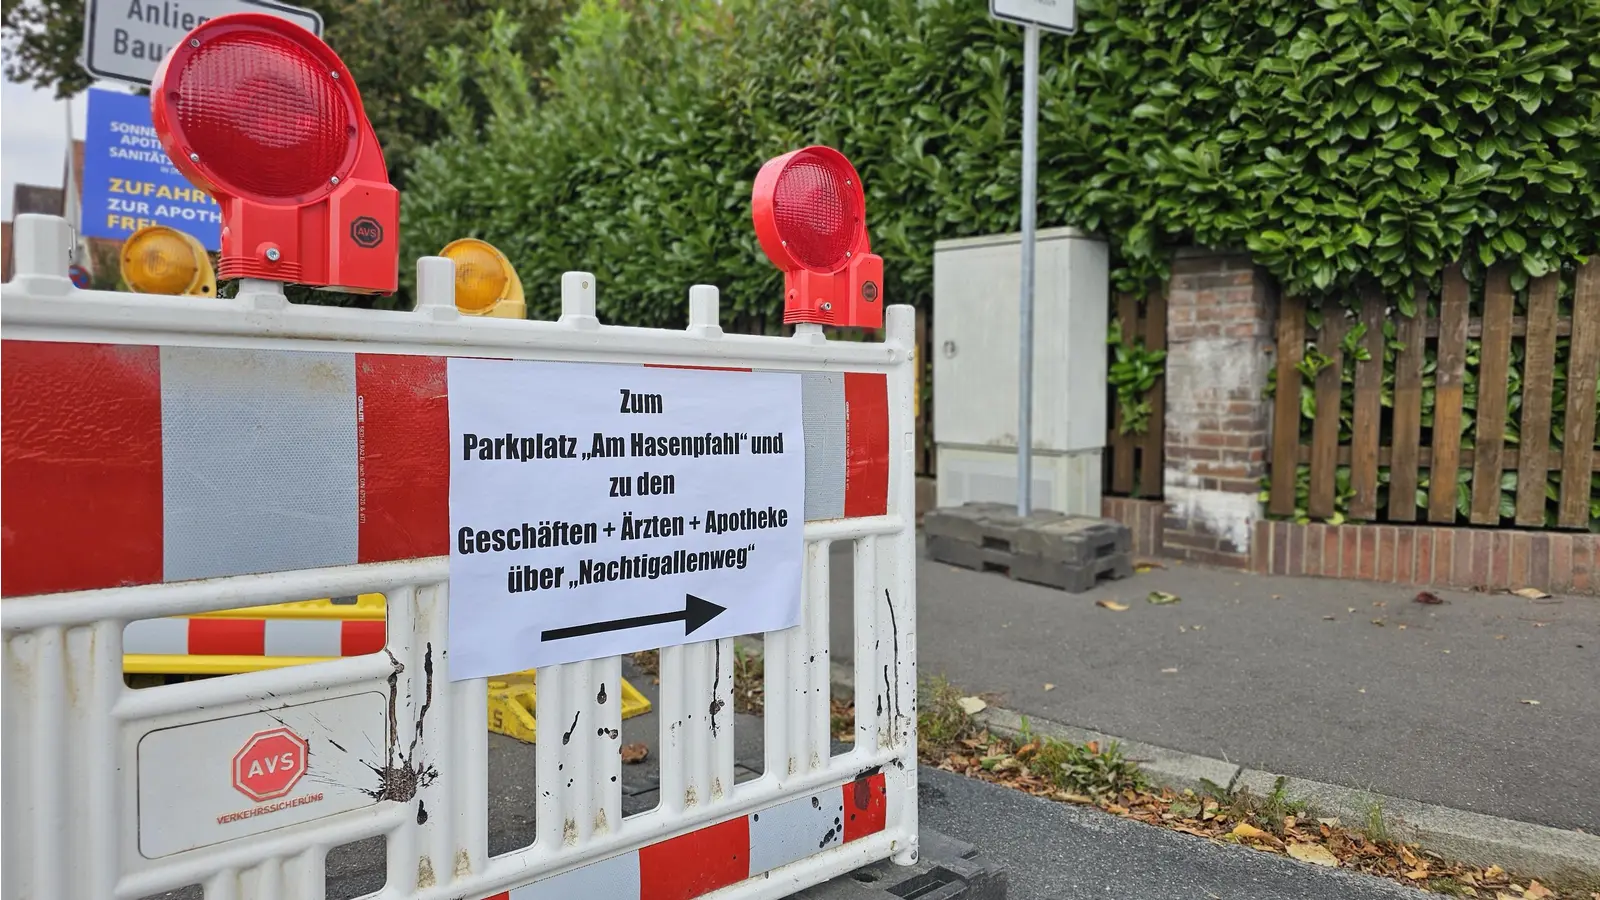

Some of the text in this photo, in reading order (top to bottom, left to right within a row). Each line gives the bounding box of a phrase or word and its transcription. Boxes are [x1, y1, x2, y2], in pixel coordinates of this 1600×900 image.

[127, 0, 210, 31] Anlie
[114, 28, 172, 62] Bau
[107, 198, 222, 224] ZUR APOTH
[358, 227, 377, 238] AVS
[619, 388, 663, 414] Zum
[463, 432, 784, 463] Parkplatz „Am Hasenpfahl“ und
[609, 471, 675, 498] zu den
[458, 506, 788, 555] Geschäften + Ärzten + Apotheke
[507, 543, 755, 594] über „Nachtigallenweg“
[247, 752, 295, 779] AVS
[216, 792, 324, 826] VERKEHRSSICHERUNG
